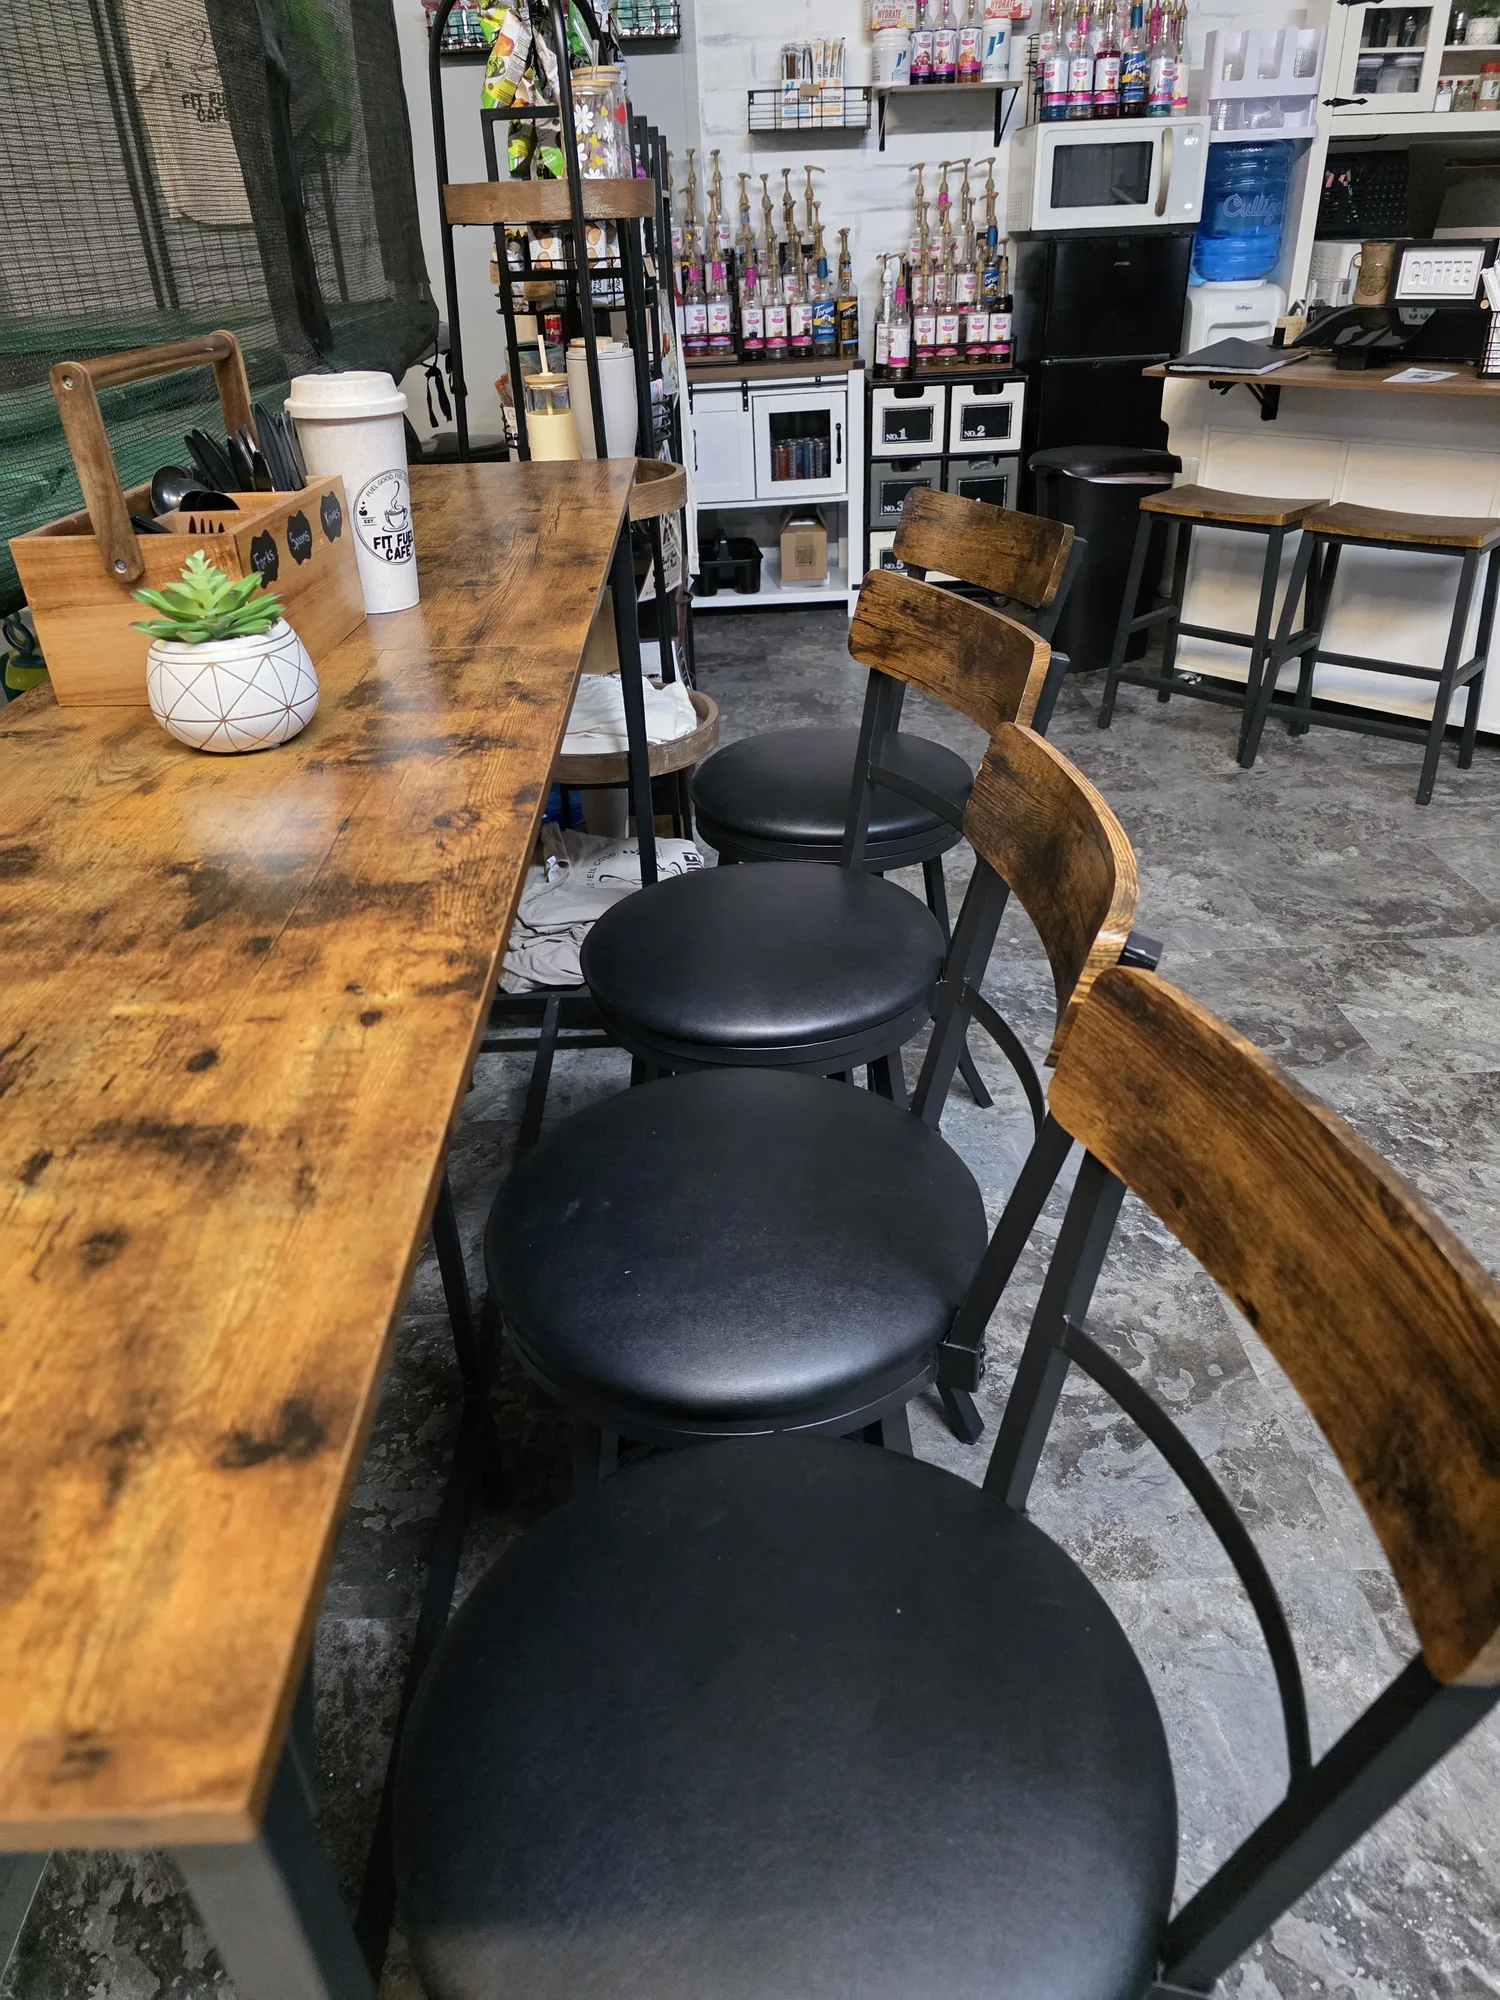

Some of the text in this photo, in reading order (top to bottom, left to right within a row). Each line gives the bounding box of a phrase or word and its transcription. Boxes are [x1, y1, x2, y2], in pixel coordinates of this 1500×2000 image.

[877, 9, 902, 19] HYDRATE
[1124, 57, 1147, 77] Toran
[182, 91, 204, 109] FIT
[197, 108, 226, 123] CAF
[1407, 260, 1473, 286] COFFEE
[885, 427, 908, 441] NO.1
[963, 424, 986, 438] NO.2
[365, 484, 380, 498] FUEL
[288, 530, 311, 551] Spoons
[373, 534, 393, 550] FIT
[252, 549, 276, 572] Forks
[385, 544, 412, 561] CAFE
